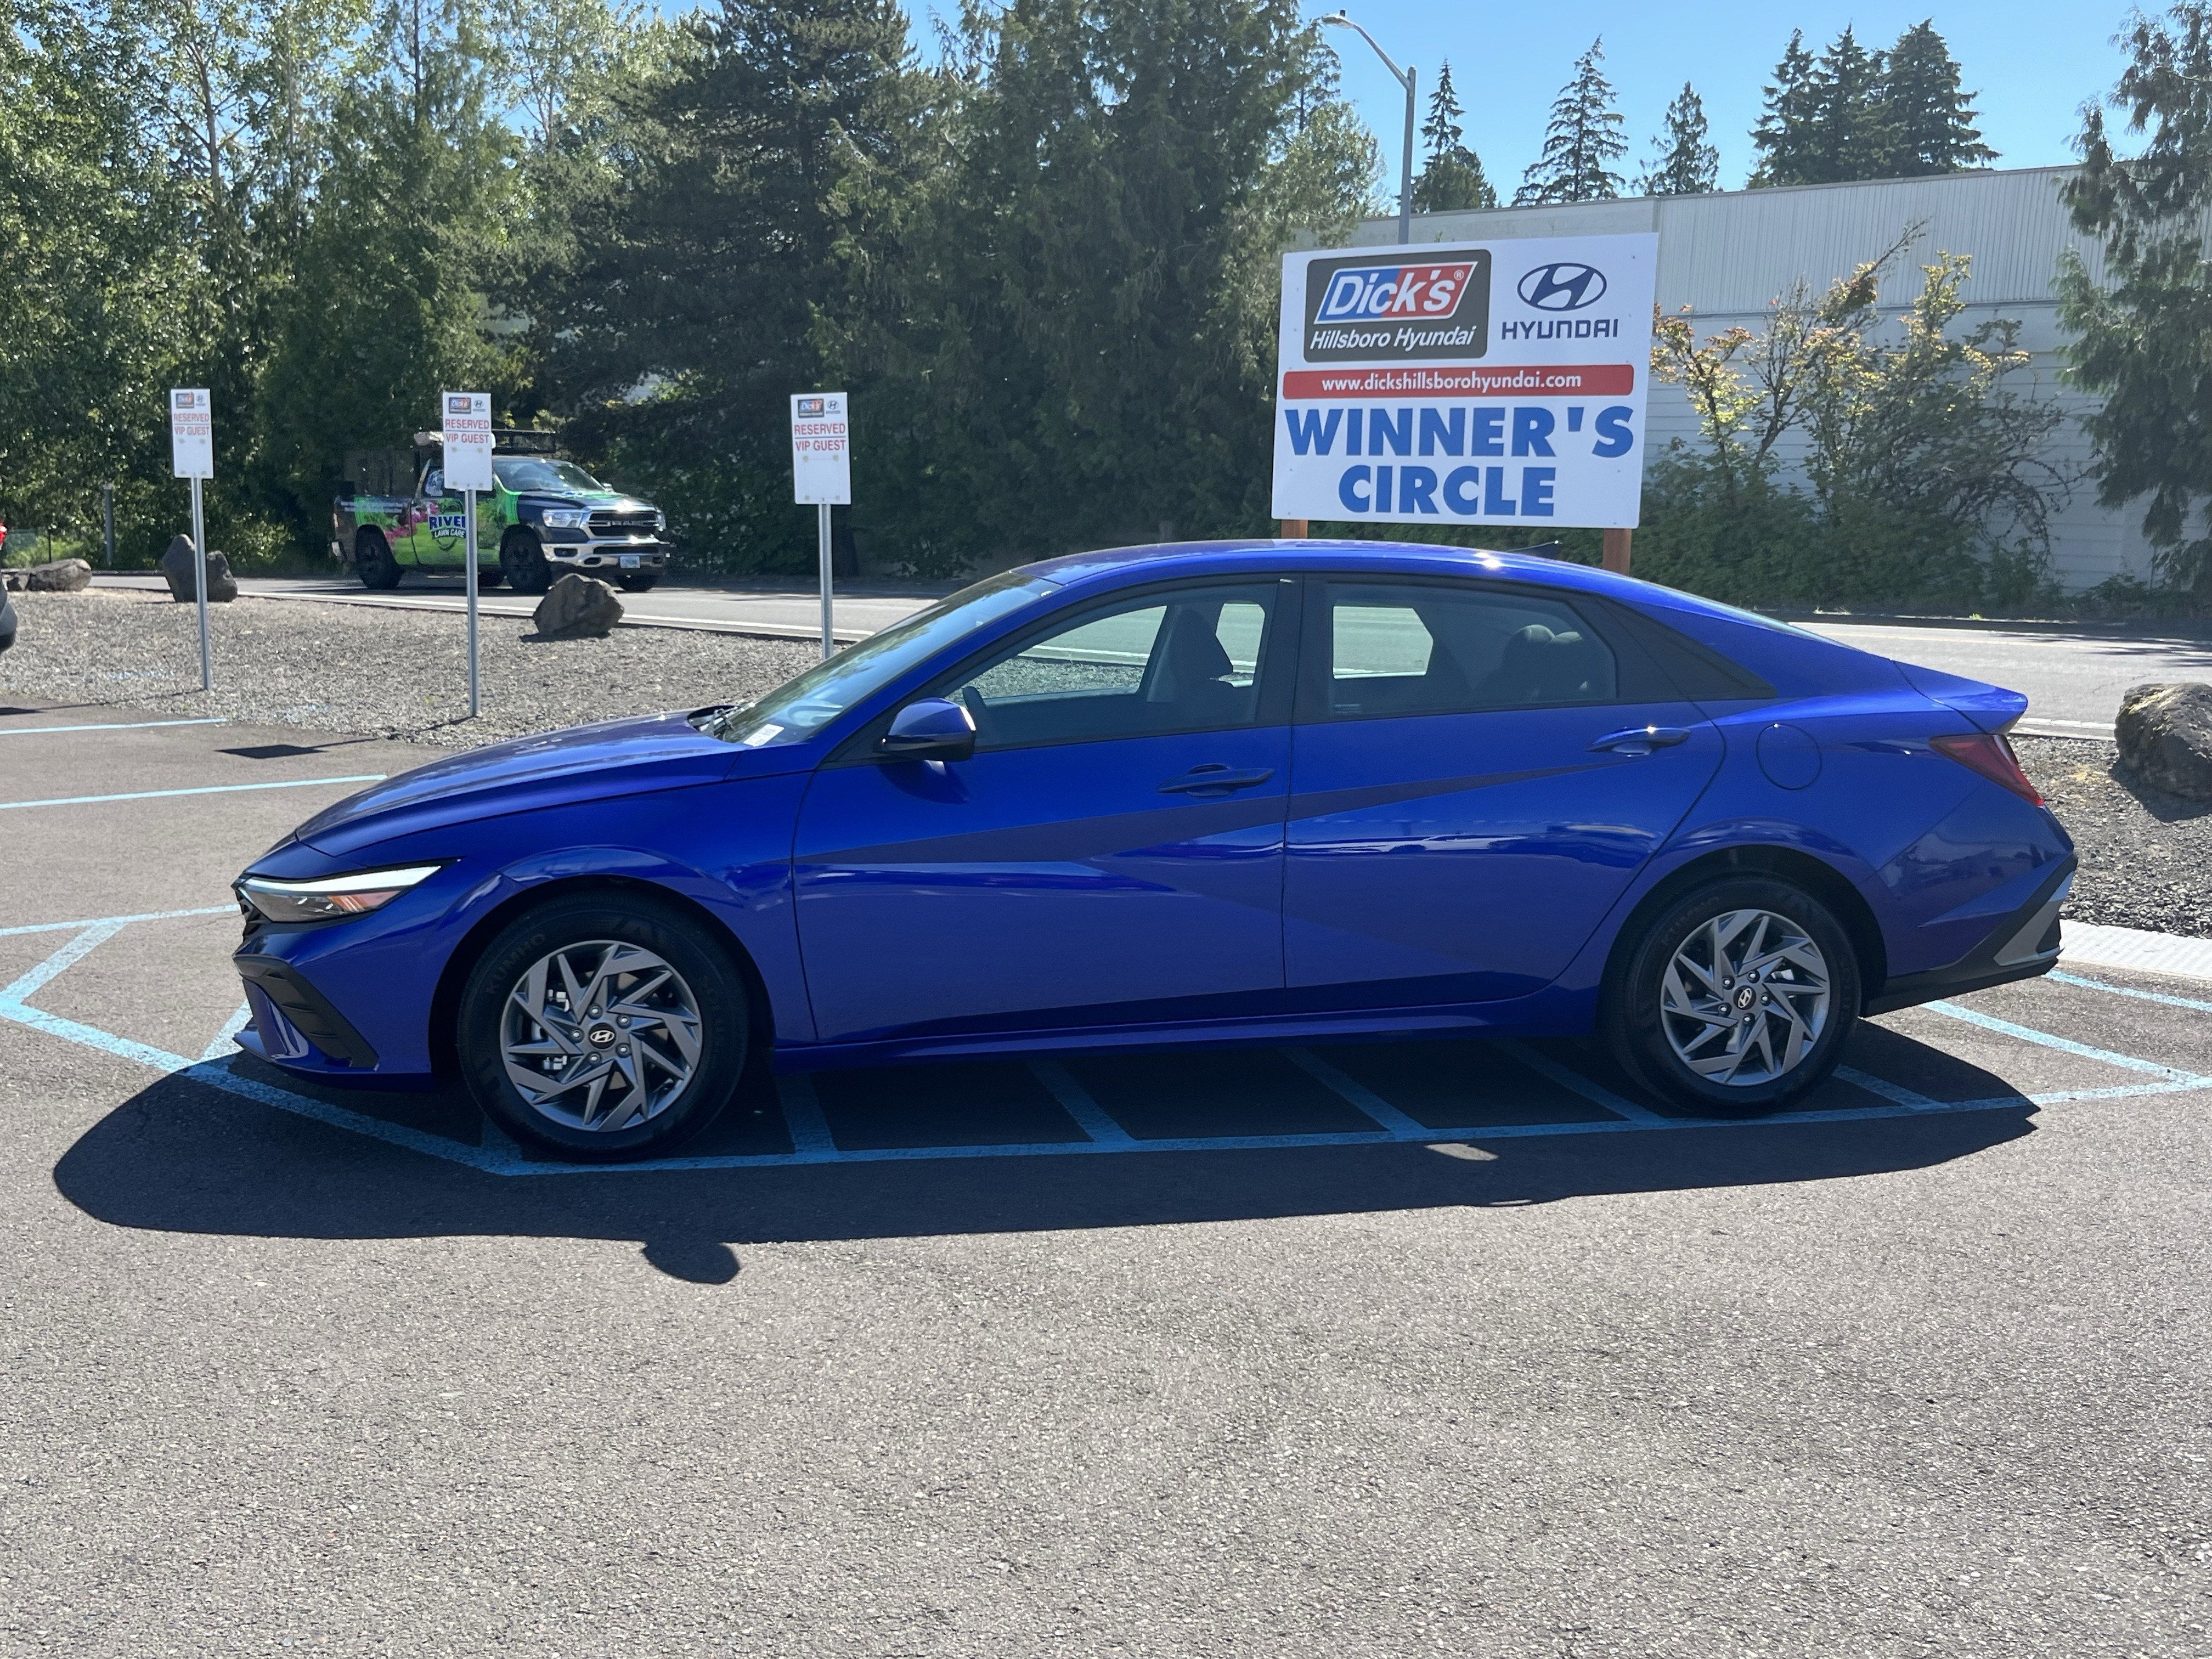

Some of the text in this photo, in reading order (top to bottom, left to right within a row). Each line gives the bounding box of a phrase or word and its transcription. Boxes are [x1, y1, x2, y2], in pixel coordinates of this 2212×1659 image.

[1502, 319, 1618, 340] HYUNDAI
[1310, 326, 1477, 352] Hillsboro Hyundai
[1322, 370, 1581, 393] www.dickshillsborohyundai.com
[173, 413, 210, 422] RESERVED
[445, 419, 489, 429] RESERVED
[794, 423, 845, 435] RESERVED
[174, 426, 210, 436] VIP GUEST
[1285, 406, 1634, 458] WINNER'S
[446, 433, 489, 444] VIP GUEST
[795, 440, 846, 452] VIP GUEST
[1339, 465, 1556, 516] CIRCLE
[434, 528, 465, 538] LAWN CARE
